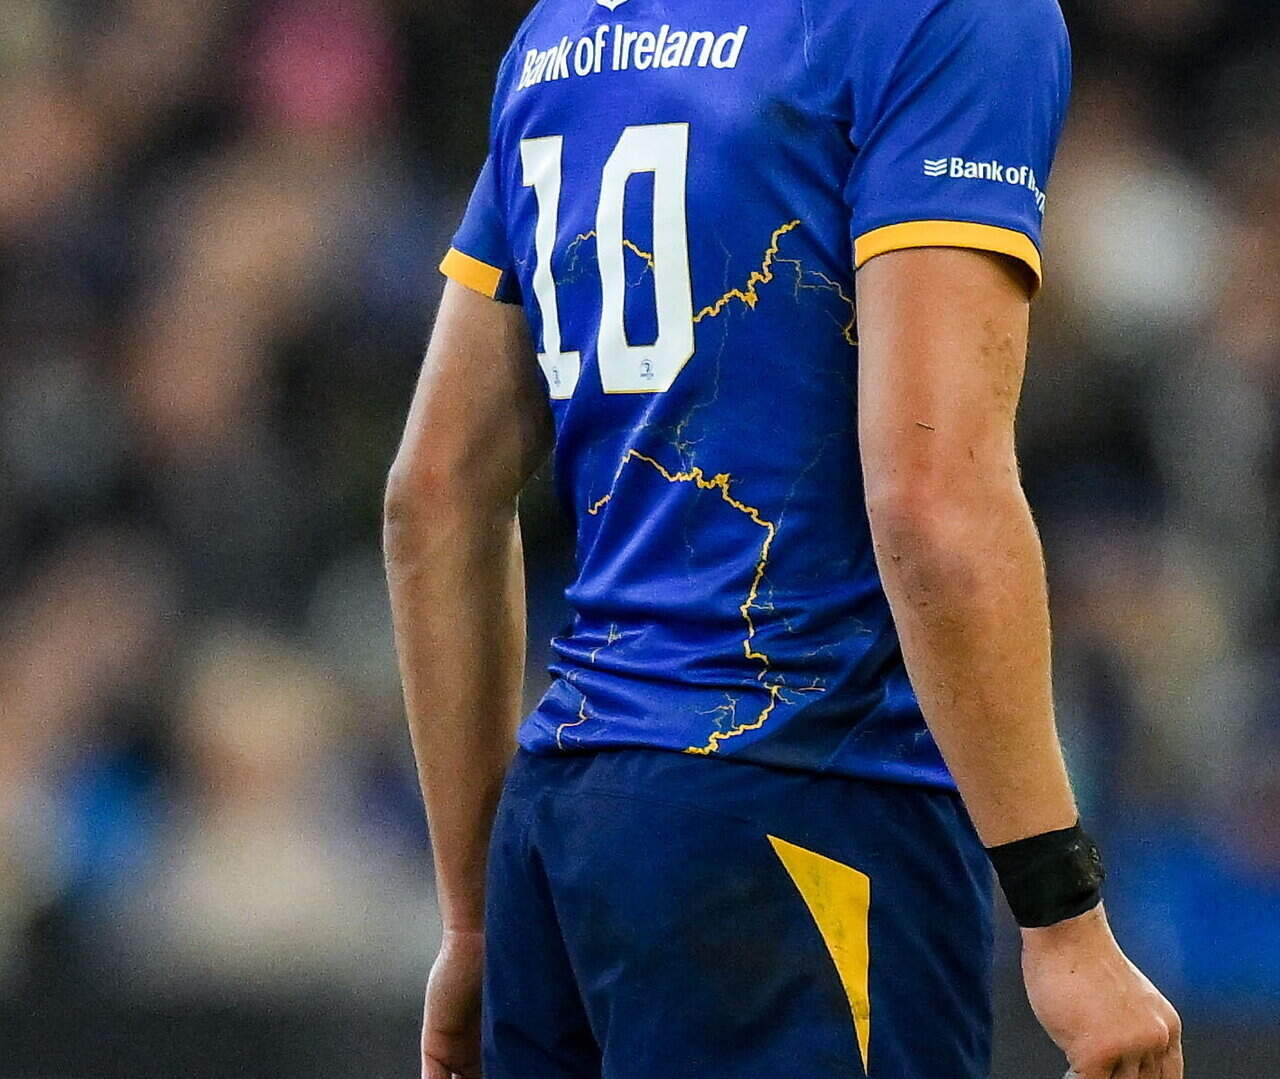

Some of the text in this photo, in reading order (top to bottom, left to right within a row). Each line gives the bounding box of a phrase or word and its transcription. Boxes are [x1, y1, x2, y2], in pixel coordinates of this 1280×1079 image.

[517, 24, 748, 91] Bank of Ireland
[949, 157, 1029, 185] Bank of
[520, 122, 695, 400] 10
